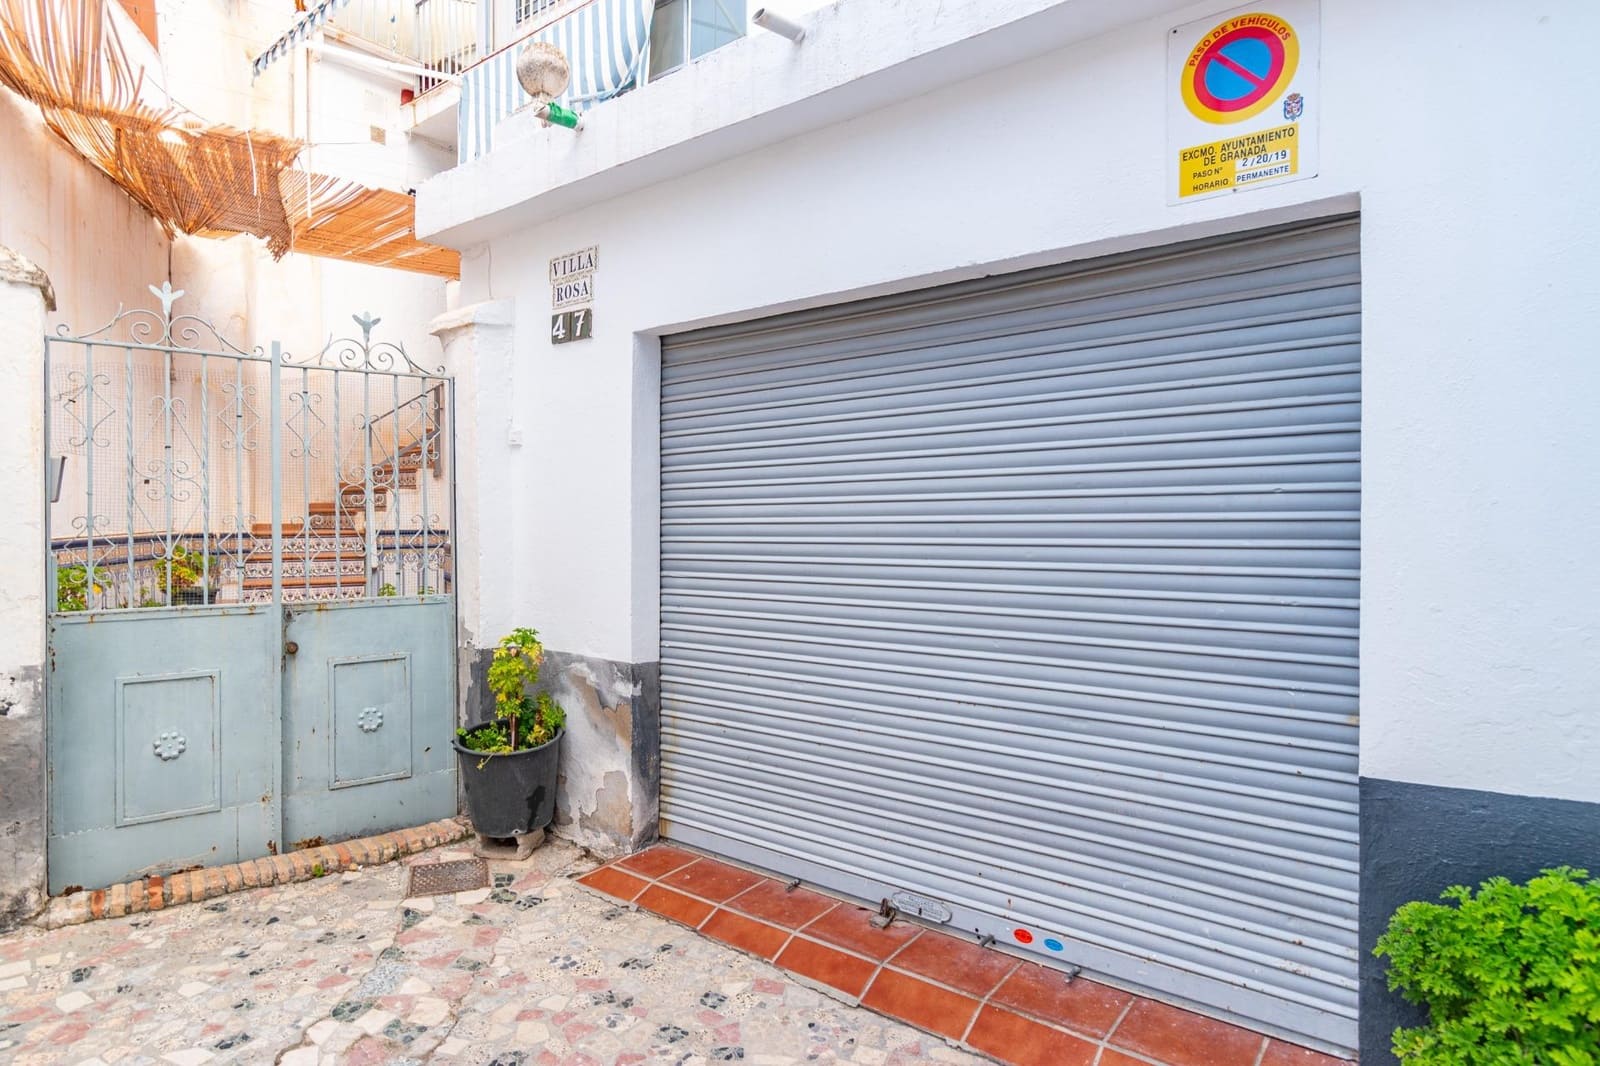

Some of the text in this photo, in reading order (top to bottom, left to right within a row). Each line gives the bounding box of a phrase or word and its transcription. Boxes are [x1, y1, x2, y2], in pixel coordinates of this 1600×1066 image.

[1189, 16, 1291, 66] PASO DE VEHÍCULOS
[1182, 127, 1295, 161] EXCMO. AYUNTAMIENTO
[1203, 144, 1267, 166] DE GRANADA
[1192, 168, 1212, 179] PASO
[1192, 165, 1289, 191] HORARIO PERMANENTE
[553, 253, 593, 276] VILLA
[556, 280, 589, 302] ROSA
[552, 311, 586, 339] 47
